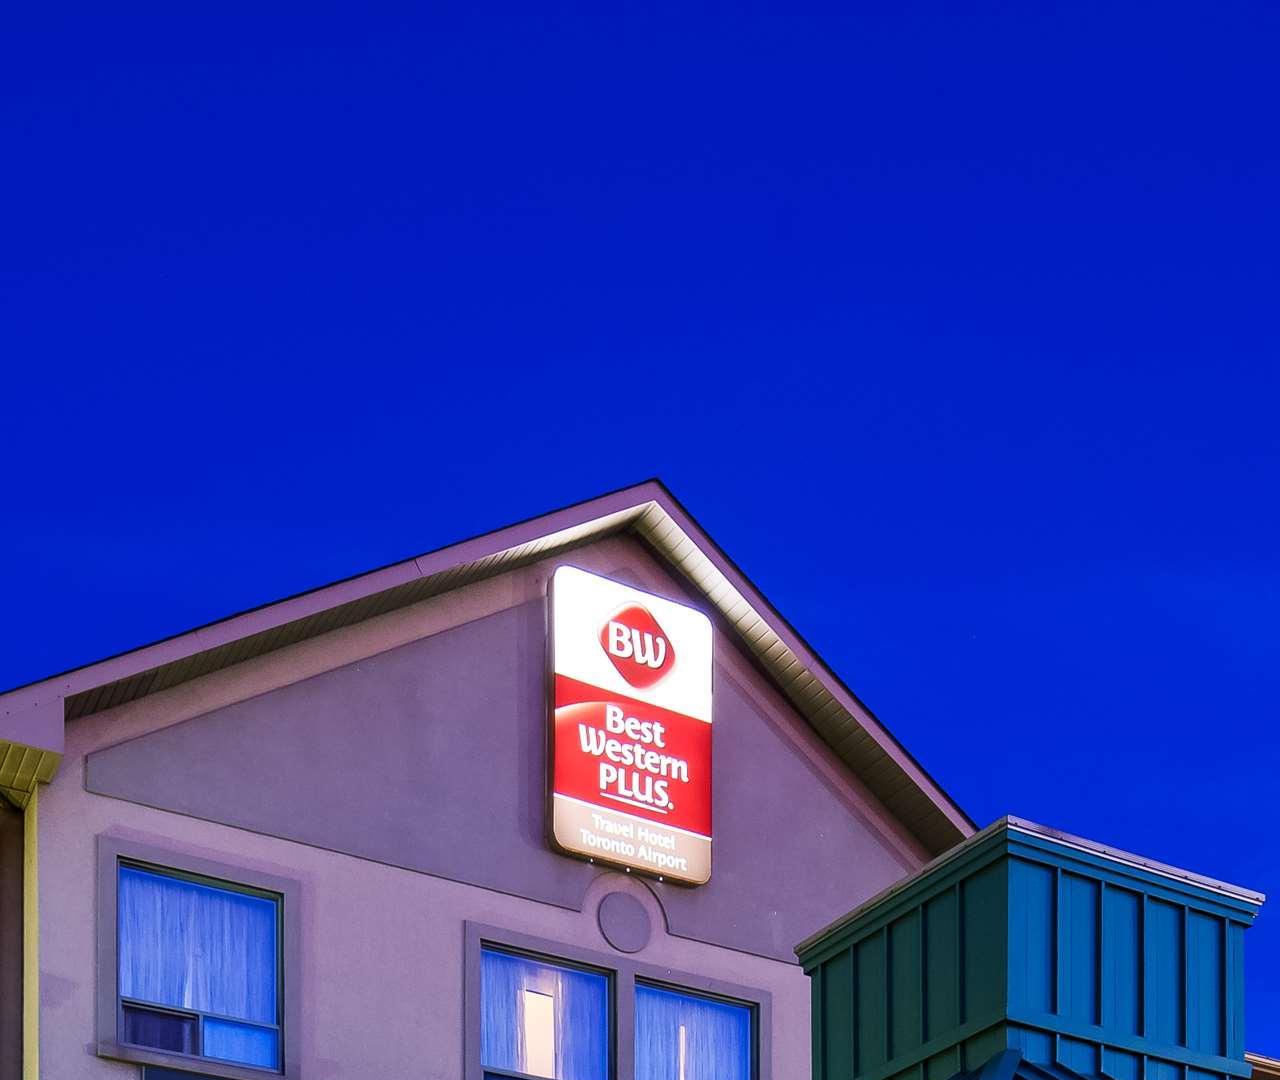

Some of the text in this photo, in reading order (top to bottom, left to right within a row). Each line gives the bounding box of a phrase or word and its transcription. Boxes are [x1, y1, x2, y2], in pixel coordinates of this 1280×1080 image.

[608, 621, 666, 669] BW
[606, 704, 665, 748] Best
[578, 724, 689, 783] Western
[580, 829, 688, 872] Toronto Airport
[592, 812, 676, 850] Travel Hotel
